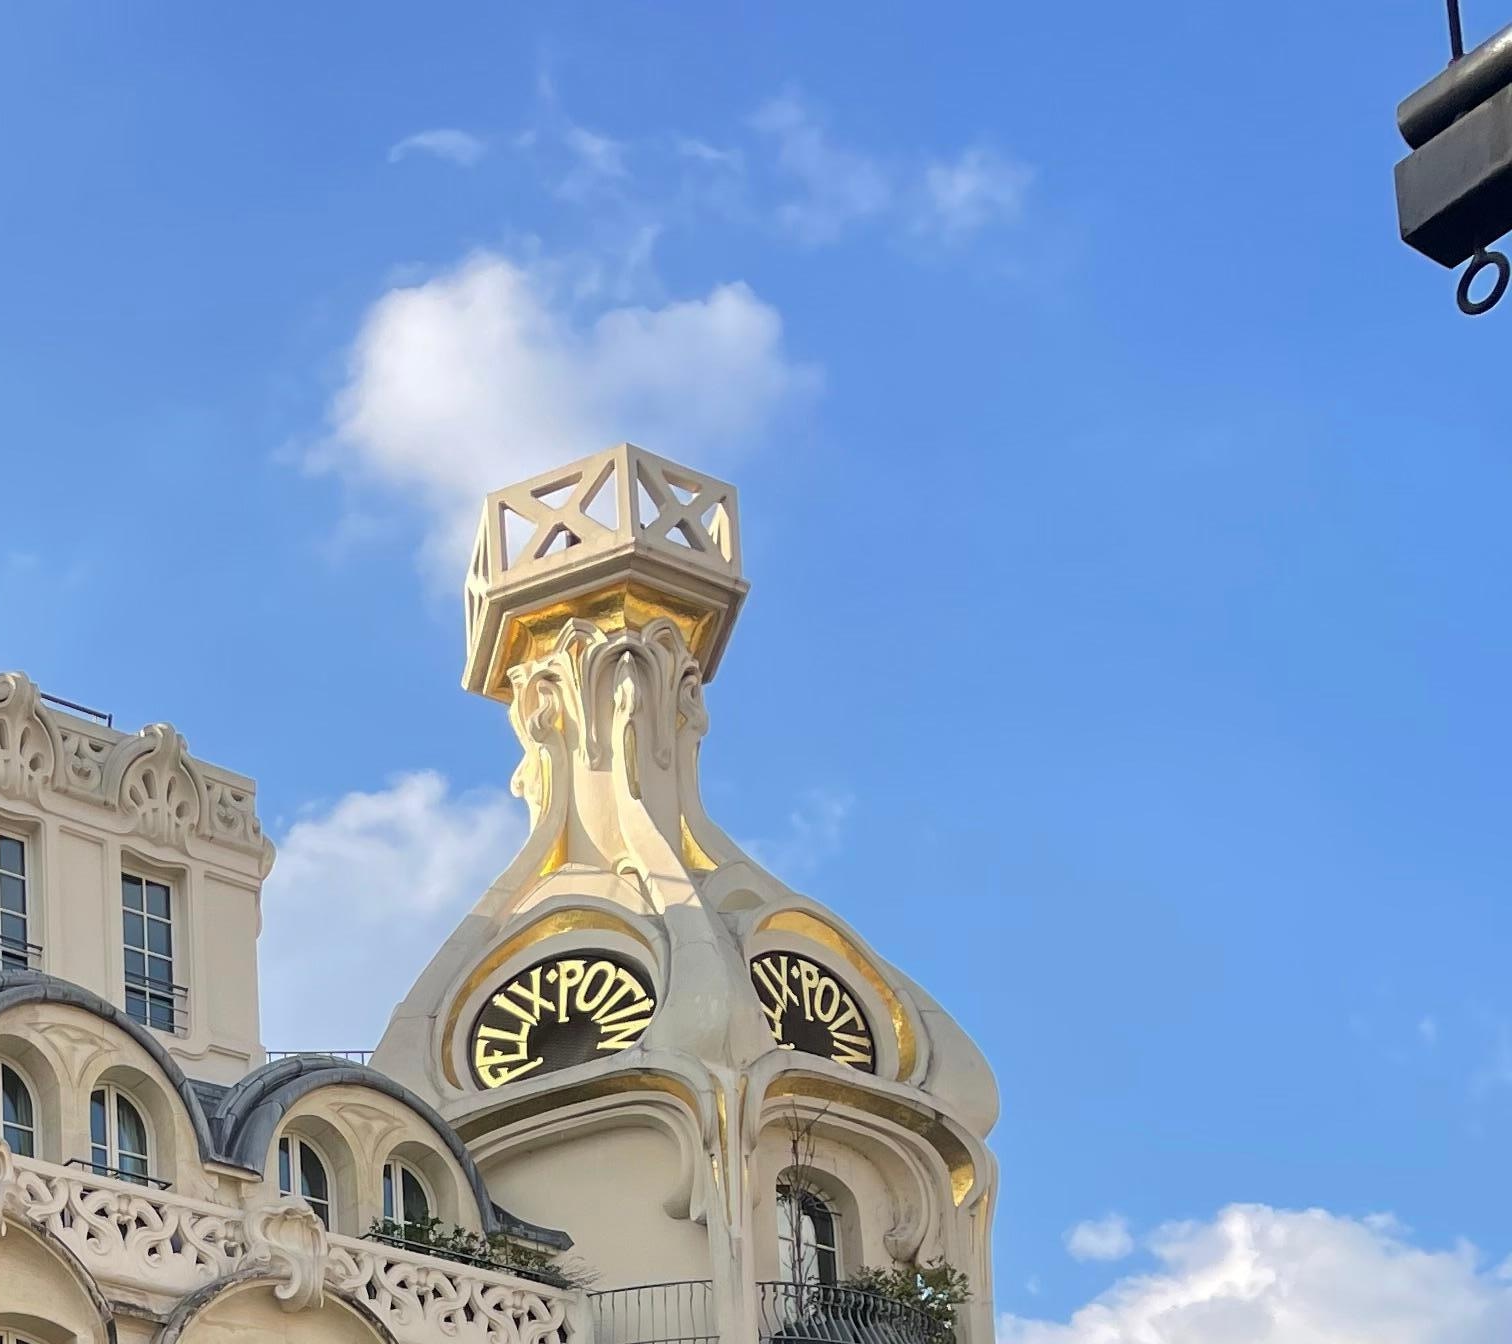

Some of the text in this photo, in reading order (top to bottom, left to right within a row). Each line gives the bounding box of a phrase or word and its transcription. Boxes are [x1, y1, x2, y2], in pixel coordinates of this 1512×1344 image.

[475, 959, 655, 1089] FELIX POTIN
[796, 959, 872, 1064] POTIN
